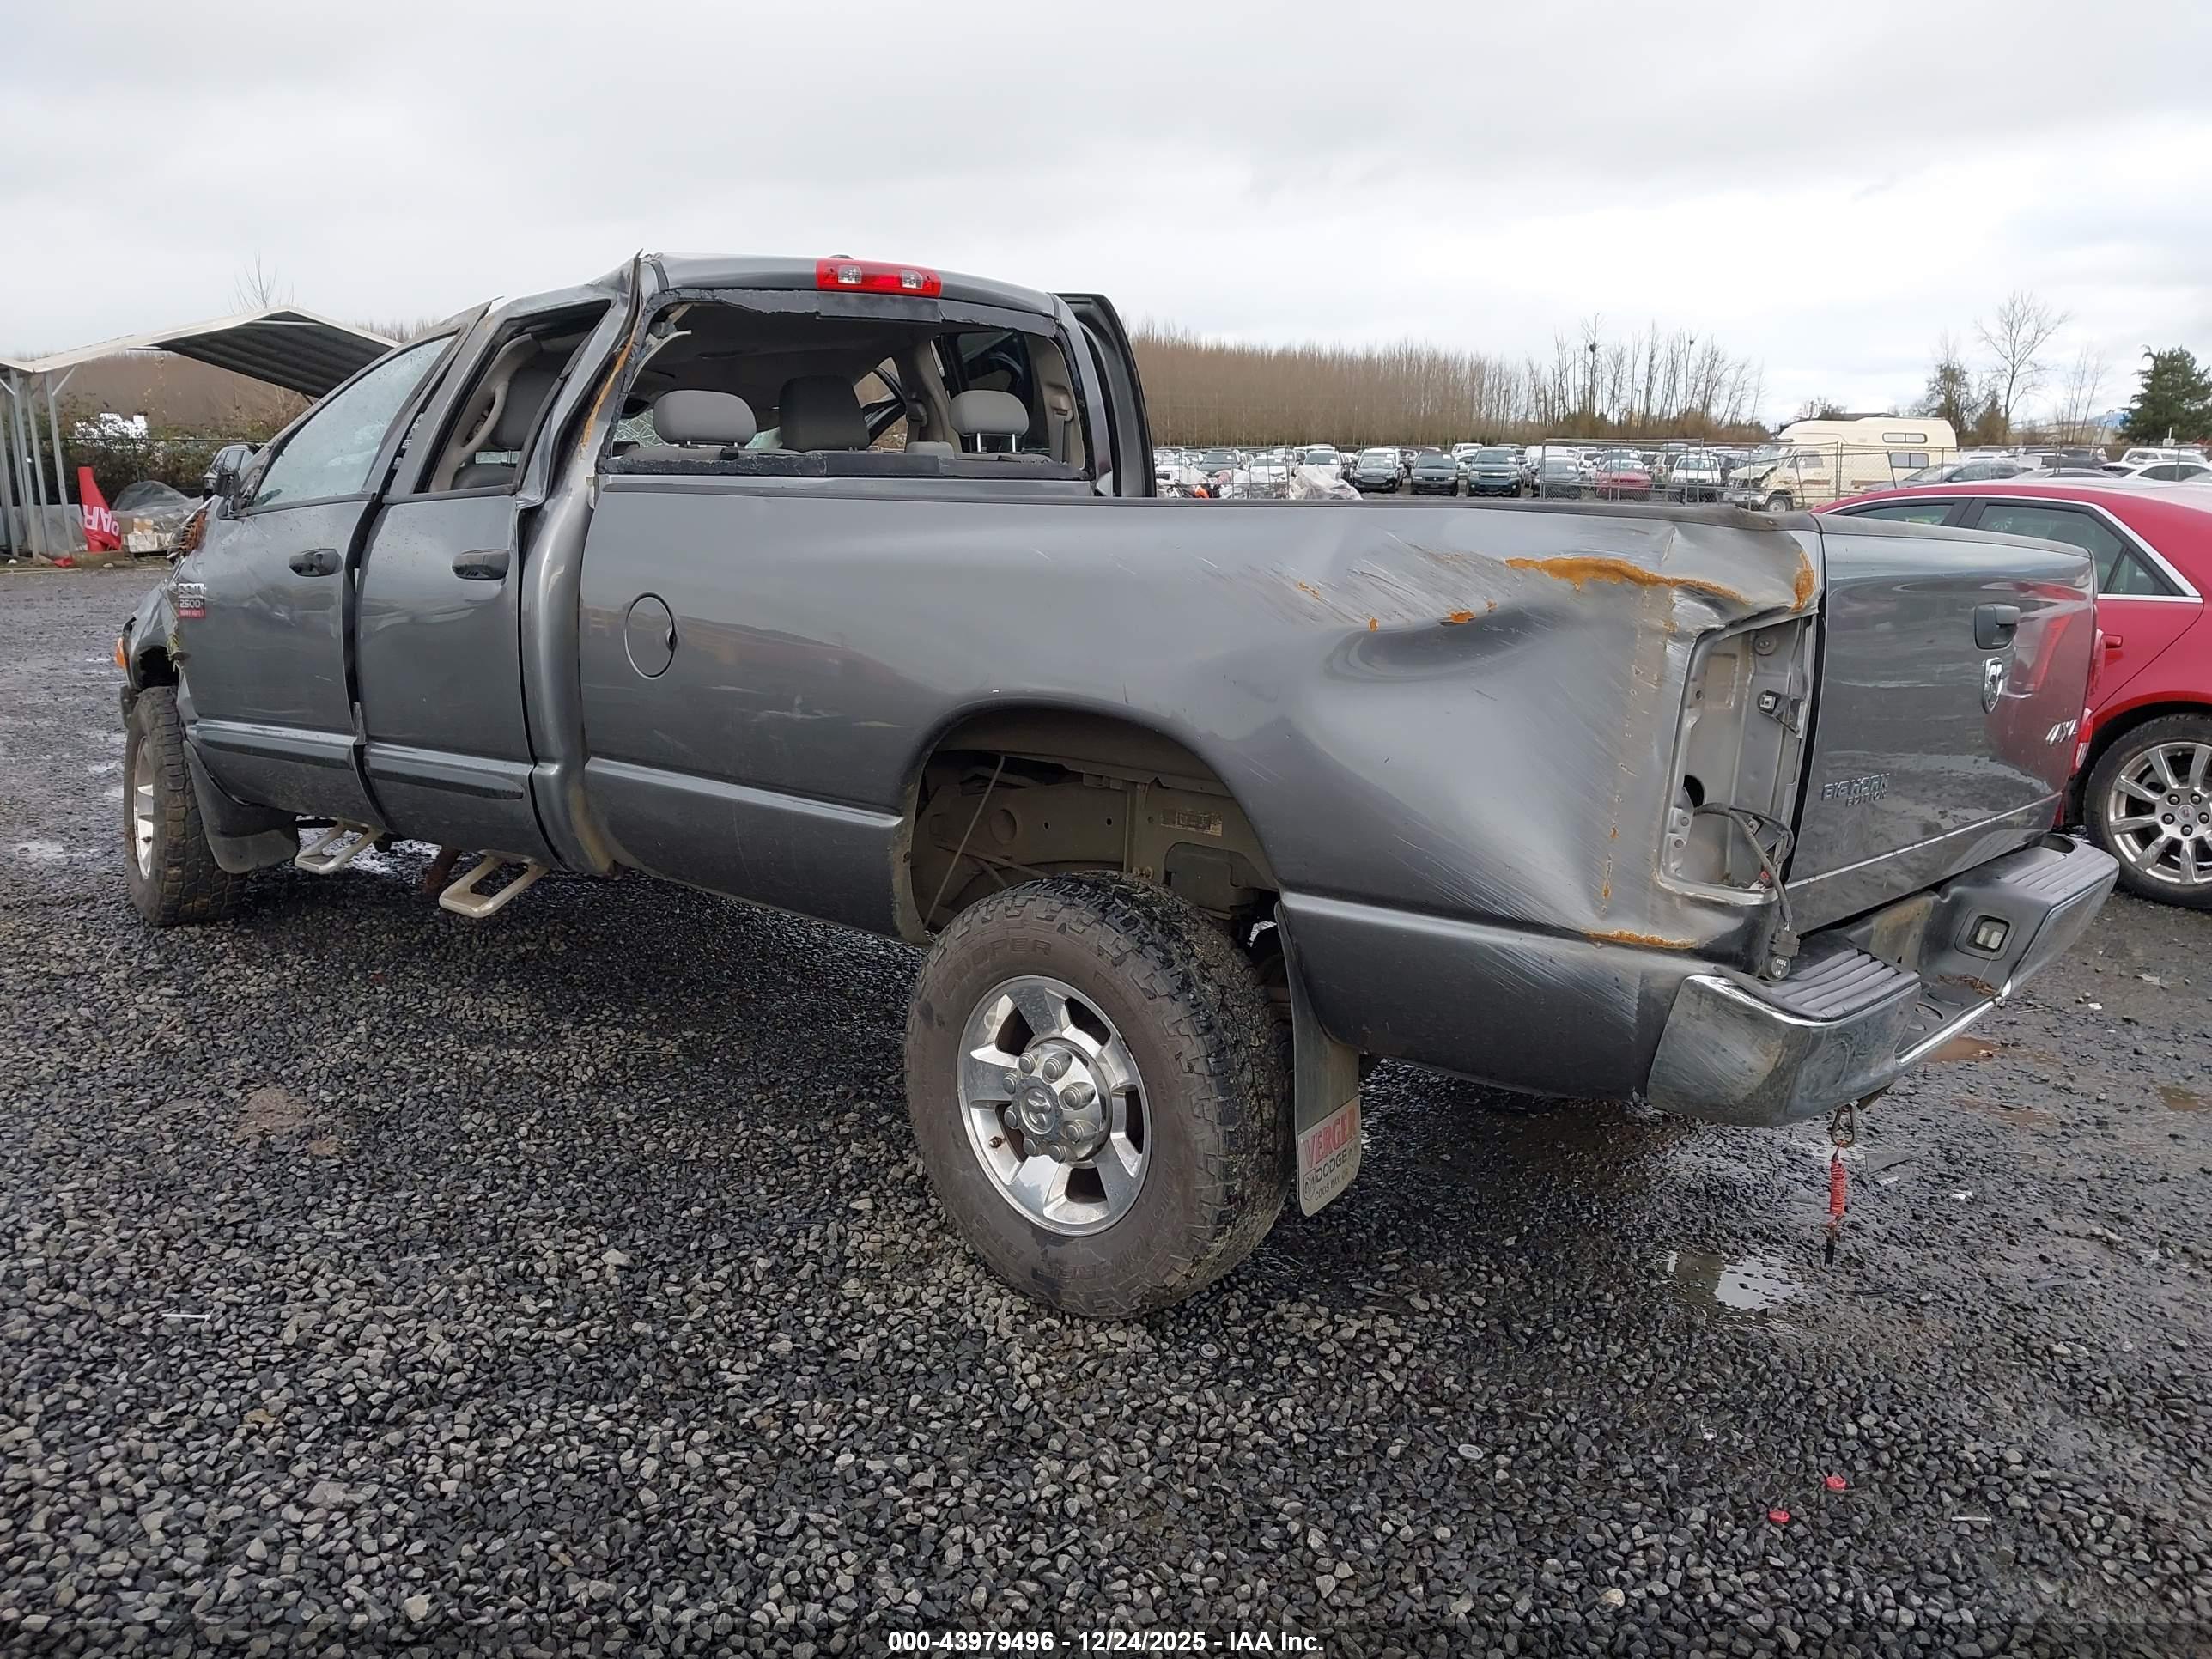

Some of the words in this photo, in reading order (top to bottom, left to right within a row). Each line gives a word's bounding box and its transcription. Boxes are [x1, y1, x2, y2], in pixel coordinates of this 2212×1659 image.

[179, 599, 201, 608] 2500
[1845, 789, 1887, 808] EDITION
[1316, 1147, 1348, 1184] DODGE
